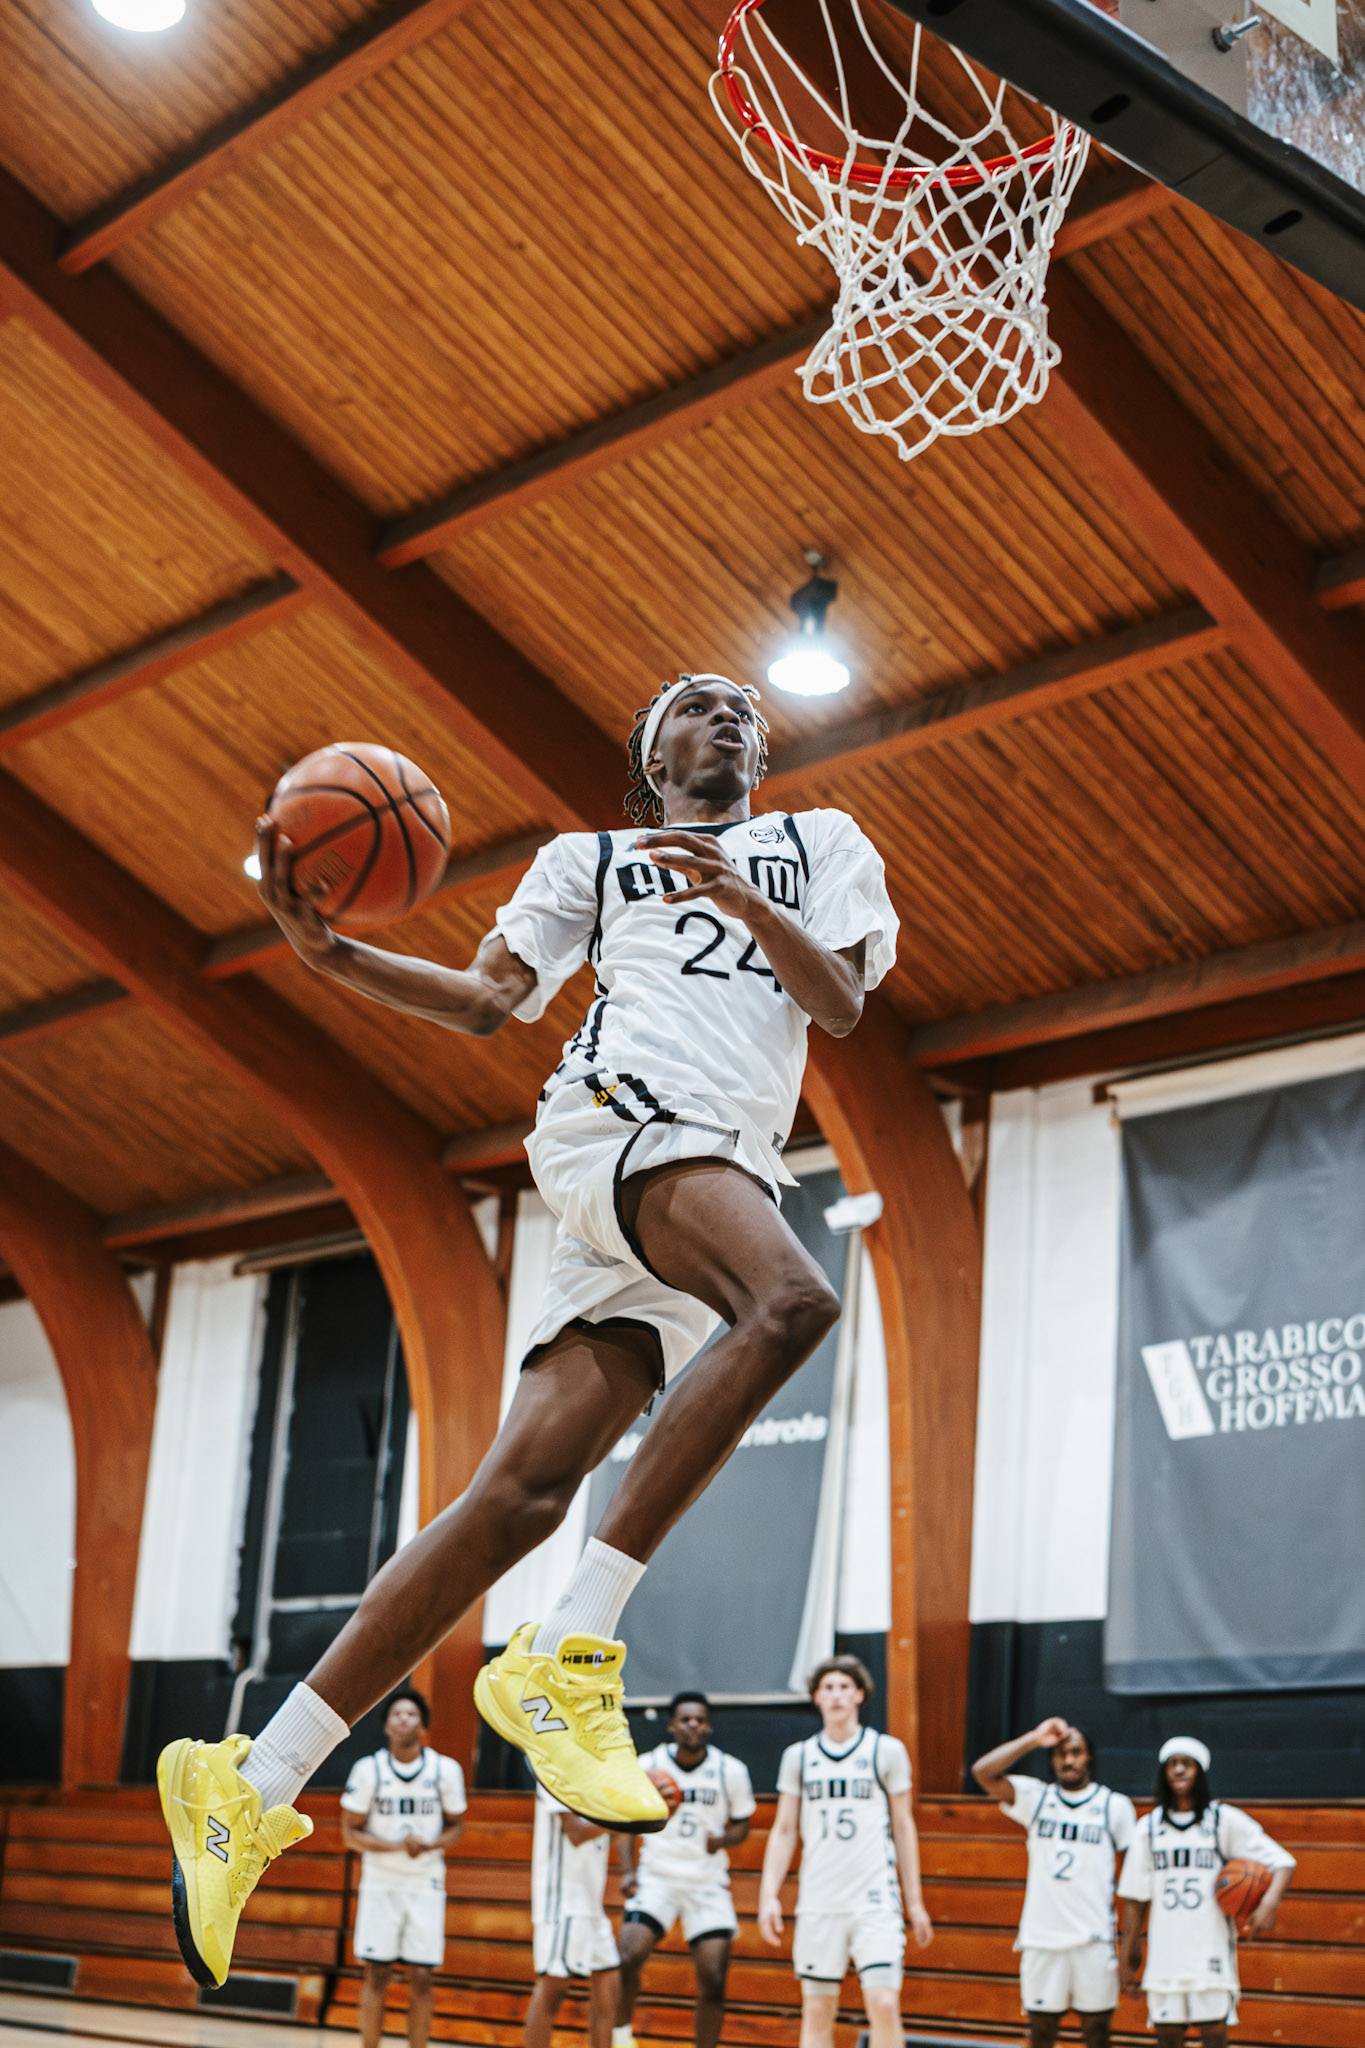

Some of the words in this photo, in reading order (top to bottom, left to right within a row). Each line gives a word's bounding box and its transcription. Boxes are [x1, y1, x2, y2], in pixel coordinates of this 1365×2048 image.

[675, 911, 782, 993] 24
[1190, 1314, 1365, 1369] TARABICO
[1206, 1350, 1362, 1402] GROSSO
[819, 1808, 857, 1840] 15
[1053, 1850, 1075, 1881] 2
[1163, 1877, 1203, 1910] 55
